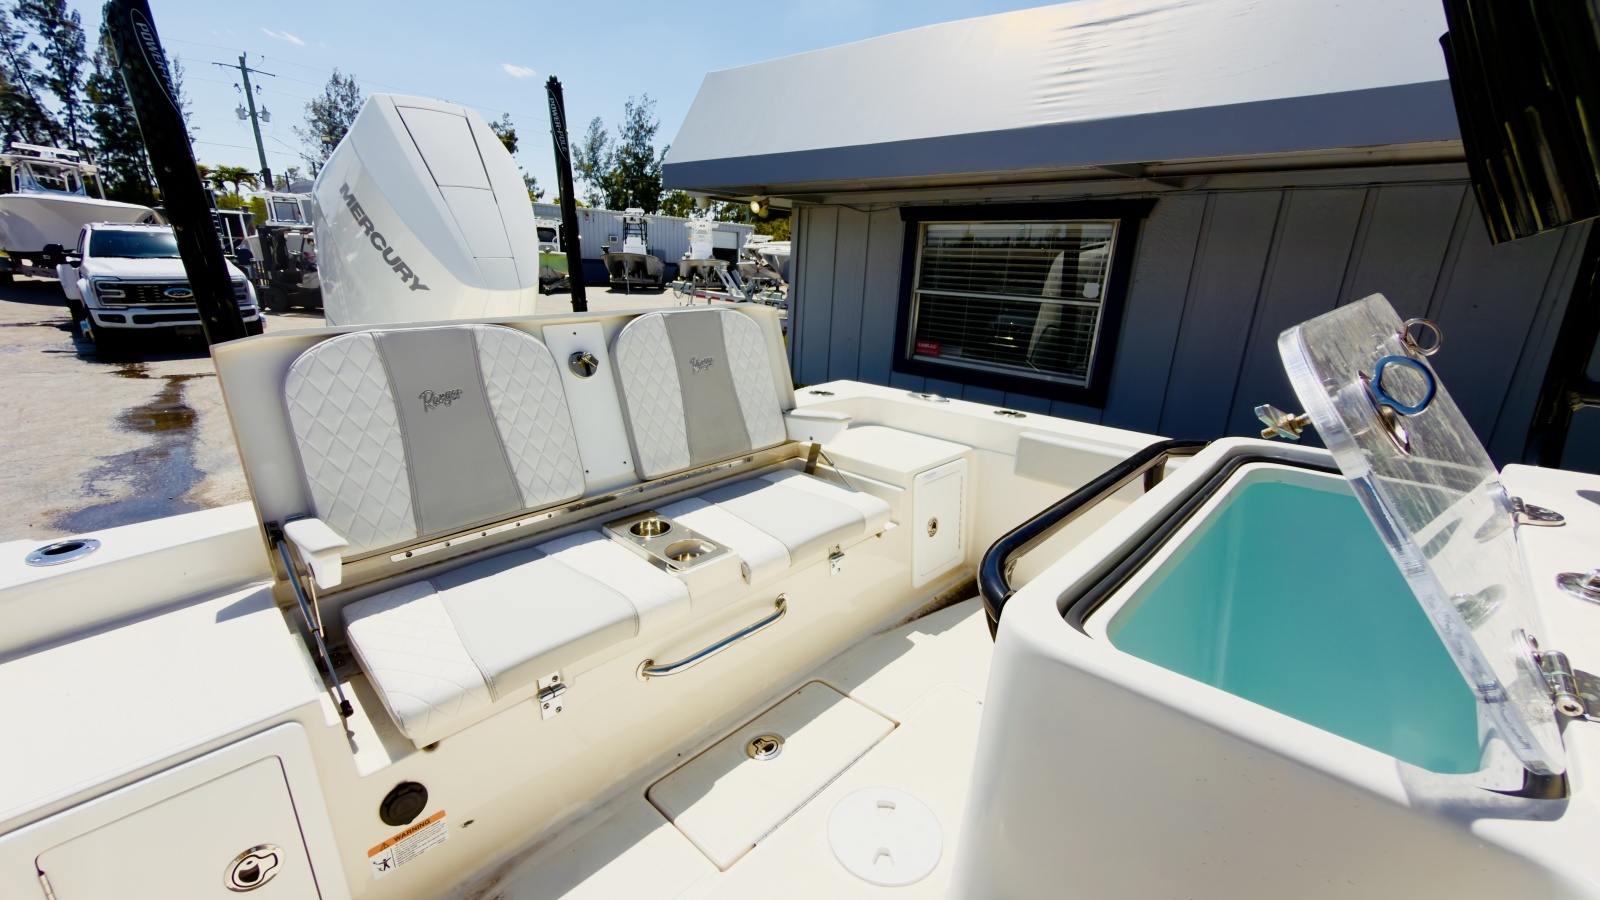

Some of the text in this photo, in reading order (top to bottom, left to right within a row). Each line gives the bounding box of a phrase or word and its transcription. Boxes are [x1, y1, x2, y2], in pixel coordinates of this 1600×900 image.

[339, 182, 430, 291] MERCURY
[418, 389, 463, 412] Ranger
[393, 819, 431, 842] WARNING
